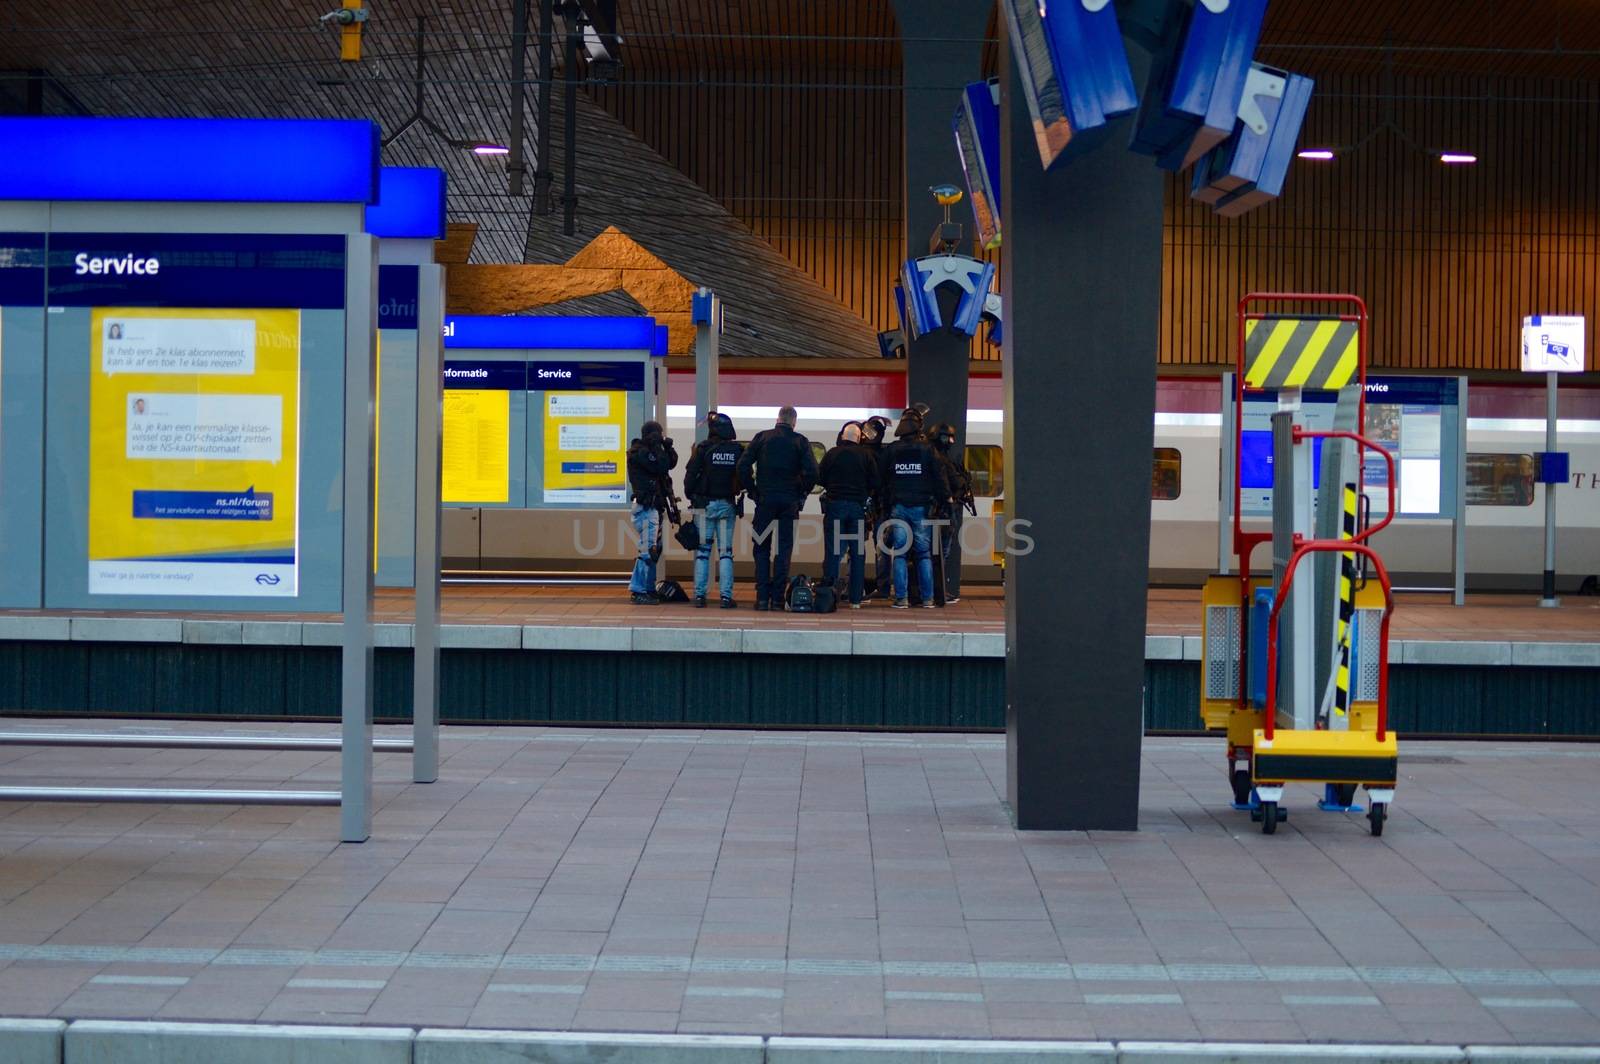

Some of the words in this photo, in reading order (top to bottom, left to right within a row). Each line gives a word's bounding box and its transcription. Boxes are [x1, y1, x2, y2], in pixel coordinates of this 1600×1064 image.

[75, 252, 159, 275] Service
[118, 347, 134, 357] heb
[136, 349, 152, 358] een
[155, 347, 167, 358] 2e
[169, 347, 186, 358] klas
[107, 357, 124, 367] kan
[136, 358, 145, 367] af
[148, 360, 159, 368] en
[161, 358, 176, 368] toe
[191, 358, 208, 368] klas
[210, 359, 242, 370] reizen?
[538, 368, 572, 378] Service
[145, 424, 154, 434] je
[157, 423, 173, 431] kan
[175, 424, 191, 432] een
[194, 423, 239, 434] eenmalige
[132, 432, 159, 441] wissel
[160, 433, 172, 443] op
[173, 433, 182, 443] je
[184, 432, 242, 444] OV-chipkaart
[243, 433, 272, 443] zetten
[132, 441, 145, 451] via
[146, 441, 158, 451] de
[712, 453, 735, 461] POLITIE
[216, 497, 269, 507] ns.nl/forum
